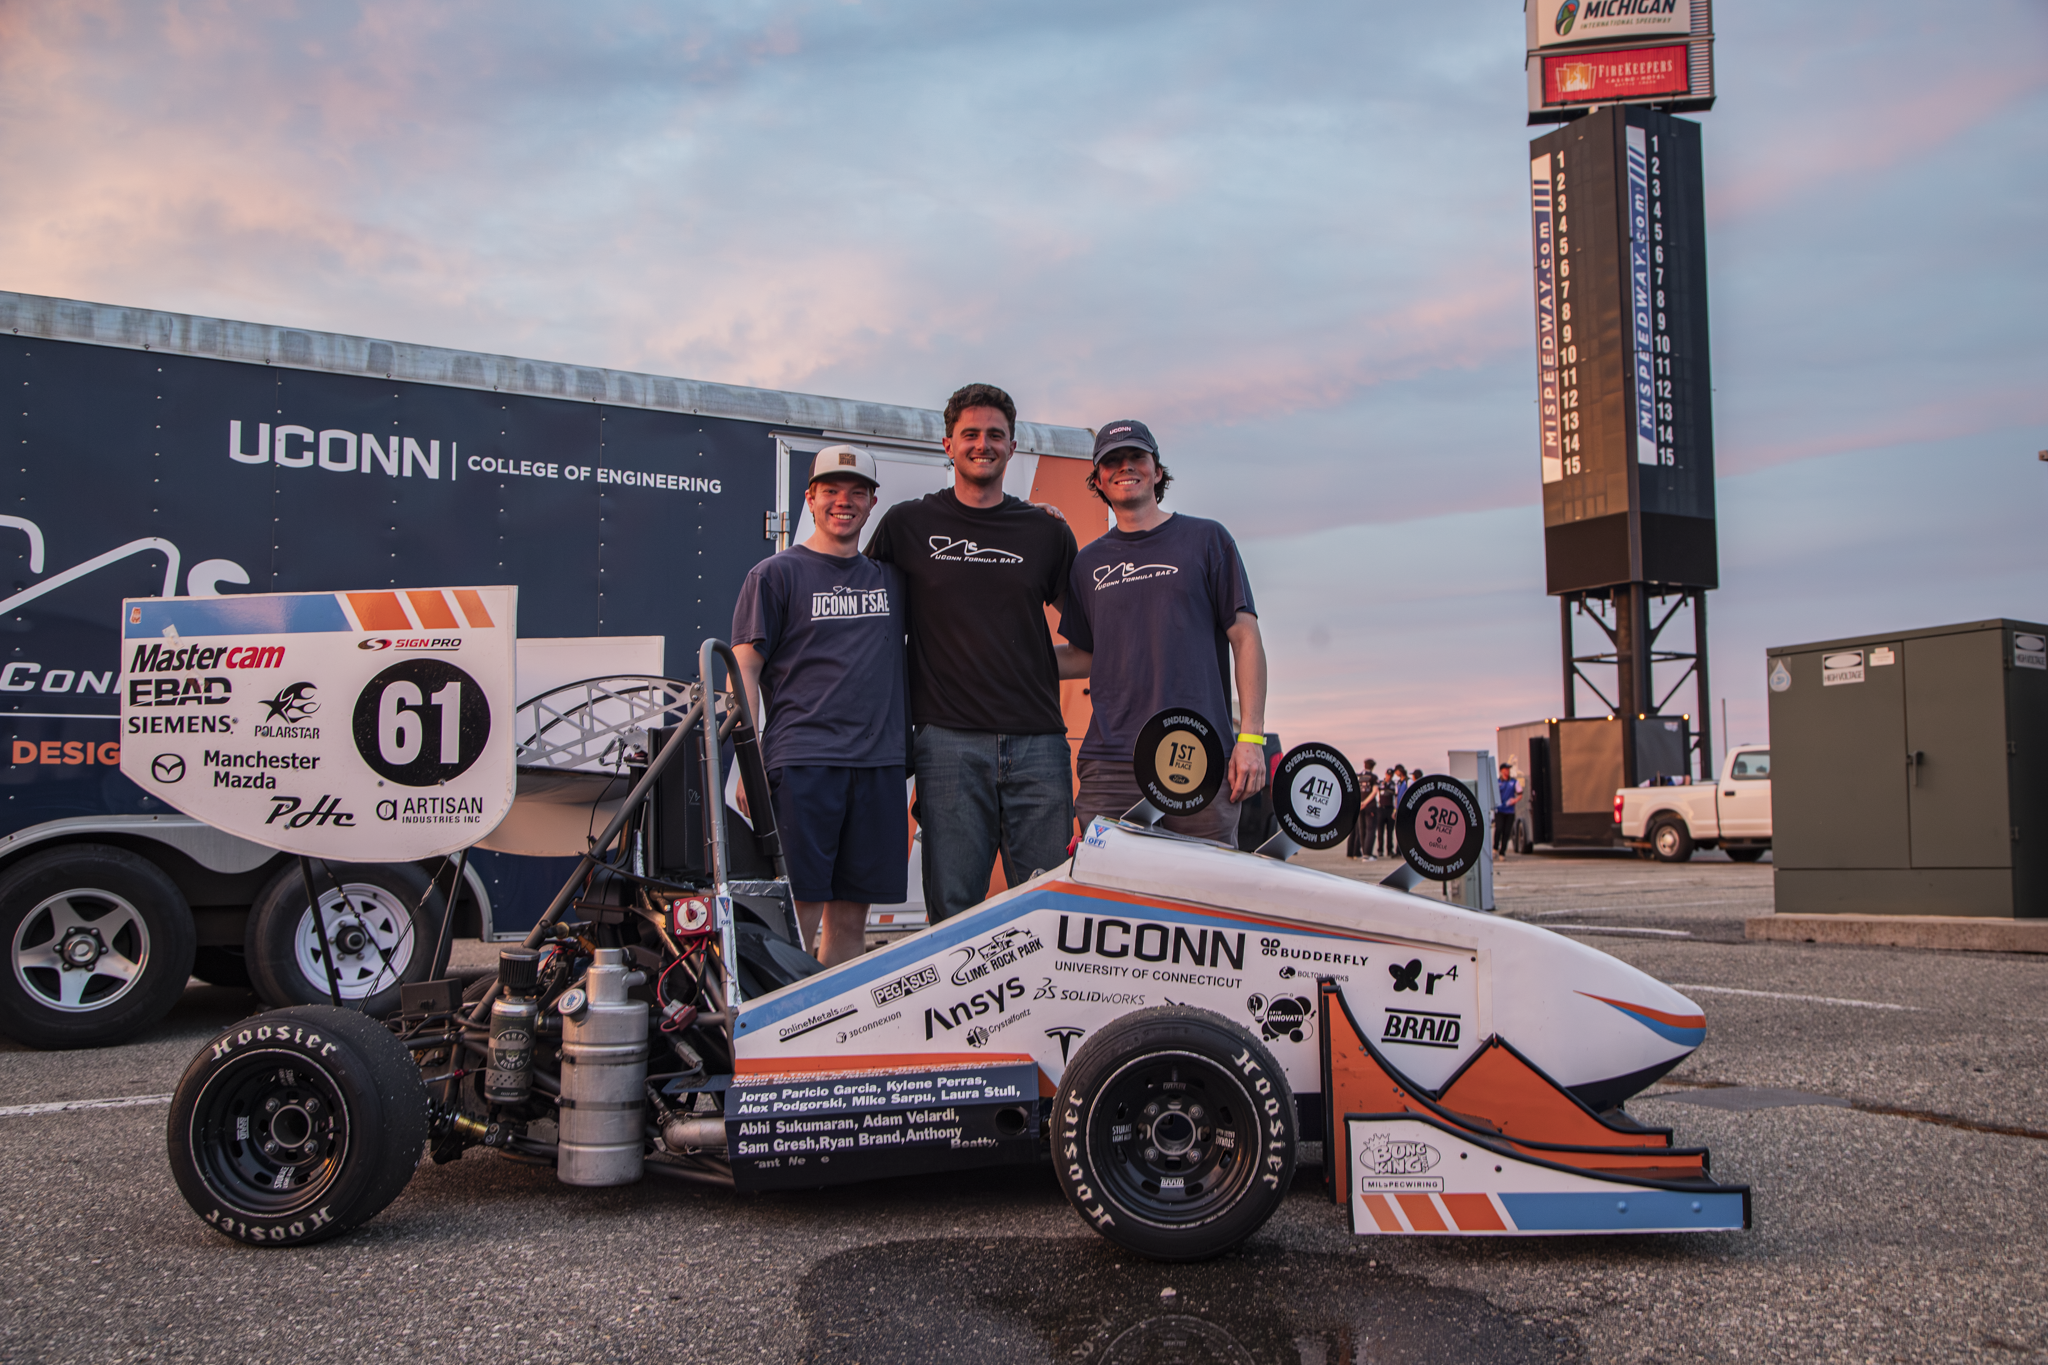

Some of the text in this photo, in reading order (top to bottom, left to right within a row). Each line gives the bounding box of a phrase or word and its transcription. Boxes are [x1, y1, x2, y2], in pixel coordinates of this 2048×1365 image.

[1584, 0, 1676, 20] MICHIGAN
[1580, 16, 1673, 30] INTERNATIONAL SPEEDWAY
[1652, 135, 1658, 152] 1
[1556, 150, 1565, 168] 1
[1652, 157, 1660, 175] 2
[1557, 173, 1566, 191] 2
[1652, 178, 1661, 196] 3
[1558, 194, 1567, 212] 3
[1653, 201, 1662, 218] 4
[1558, 216, 1568, 233] 4
[1654, 223, 1662, 241] 5
[1560, 237, 1568, 255] 5
[1655, 246, 1664, 264] 6
[1560, 260, 1570, 278] 6
[1656, 268, 1664, 285] 7
[1561, 281, 1570, 299] 7
[1656, 290, 1666, 308] 8
[1562, 303, 1571, 321] 8
[1657, 312, 1666, 330] 9
[1562, 324, 1572, 342] 9
[1655, 336, 1670, 354] 10
[1560, 345, 1577, 364] 10
[1656, 358, 1670, 376] 11
[1562, 367, 1577, 386] 11
[1656, 380, 1672, 398] 12
[1562, 390, 1578, 408] 12
[1658, 402, 1673, 421] 13
[1562, 412, 1580, 430] 13
[1109, 426, 1132, 435] UCONN
[1658, 425, 1674, 443] 14
[229, 420, 440, 480] UCONN
[1564, 433, 1580, 452] 14
[1564, 456, 1581, 475] 15
[1659, 448, 1674, 466] 15
[467, 454, 722, 494] COLLEGE OF ENGINEERING
[811, 592, 890, 617] UCONN FSAE
[395, 638, 462, 648] SIGN PRO
[129, 643, 286, 673] Mastercam
[129, 677, 232, 707] EBAD
[128, 715, 231, 734] SIEMENS
[254, 725, 320, 739] POLARSTAR
[378, 680, 462, 766] 61
[1162, 715, 1209, 736] ENDURANCE
[203, 750, 321, 769] Manchester
[1169, 741, 1196, 767] 1ST
[1174, 762, 1193, 771] PLACE
[1285, 749, 1353, 793] OVERALL COMPETITION
[213, 771, 277, 789] Mazda
[1299, 776, 1334, 801] 4TH
[1147, 781, 1183, 810] MICHIGAN
[1312, 796, 1329, 806] PLACE
[1406, 781, 1478, 827] BUSINESS PRESENTATION
[403, 797, 483, 814] ARTISAN
[1306, 805, 1322, 818] SAE
[402, 816, 461, 824] INDUSTRIES
[1424, 806, 1459, 831] 3RD
[1283, 813, 1318, 843] MICHIGAN
[1436, 826, 1453, 835] PLACE
[1088, 837, 1104, 847] OFF
[1409, 847, 1444, 874] MICHIGAN
[1057, 914, 1246, 971] UCONN
[964, 937, 1044, 984] LIME ROCK PARK
[1281, 948, 1369, 967] BUDDERFLY
[1055, 960, 1243, 990] UNIVERSITY OF CONNECTICUT
[875, 968, 936, 1003] PEGASUS
[1060, 989, 1146, 1006] SOLIDWORKS
[924, 976, 1026, 1042] Ansys
[1268, 1014, 1303, 1022] INNOVATE
[779, 1003, 855, 1037] OnlineMetals.com
[988, 1008, 1031, 1034] Crystalfontz
[1384, 1015, 1461, 1042] BRAID
[211, 1025, 337, 1062] Hoosier
[740, 1076, 987, 1103] Jorge Paricio Garcia, Kylene Perras,
[738, 1085, 1021, 1114] Alex Podgorski, Mike Sarpu, Laura Stull,
[739, 1108, 960, 1136] Abhi Sukumaran, Adam Velardi,
[1231, 1048, 1286, 1191] Hoosier
[738, 1141, 769, 1154] Sam
[1373, 1142, 1427, 1163] BUNG
[1063, 1089, 1116, 1228] Hoosier
[1374, 1157, 1422, 1174] KING
[206, 1205, 335, 1242] Hoosier
